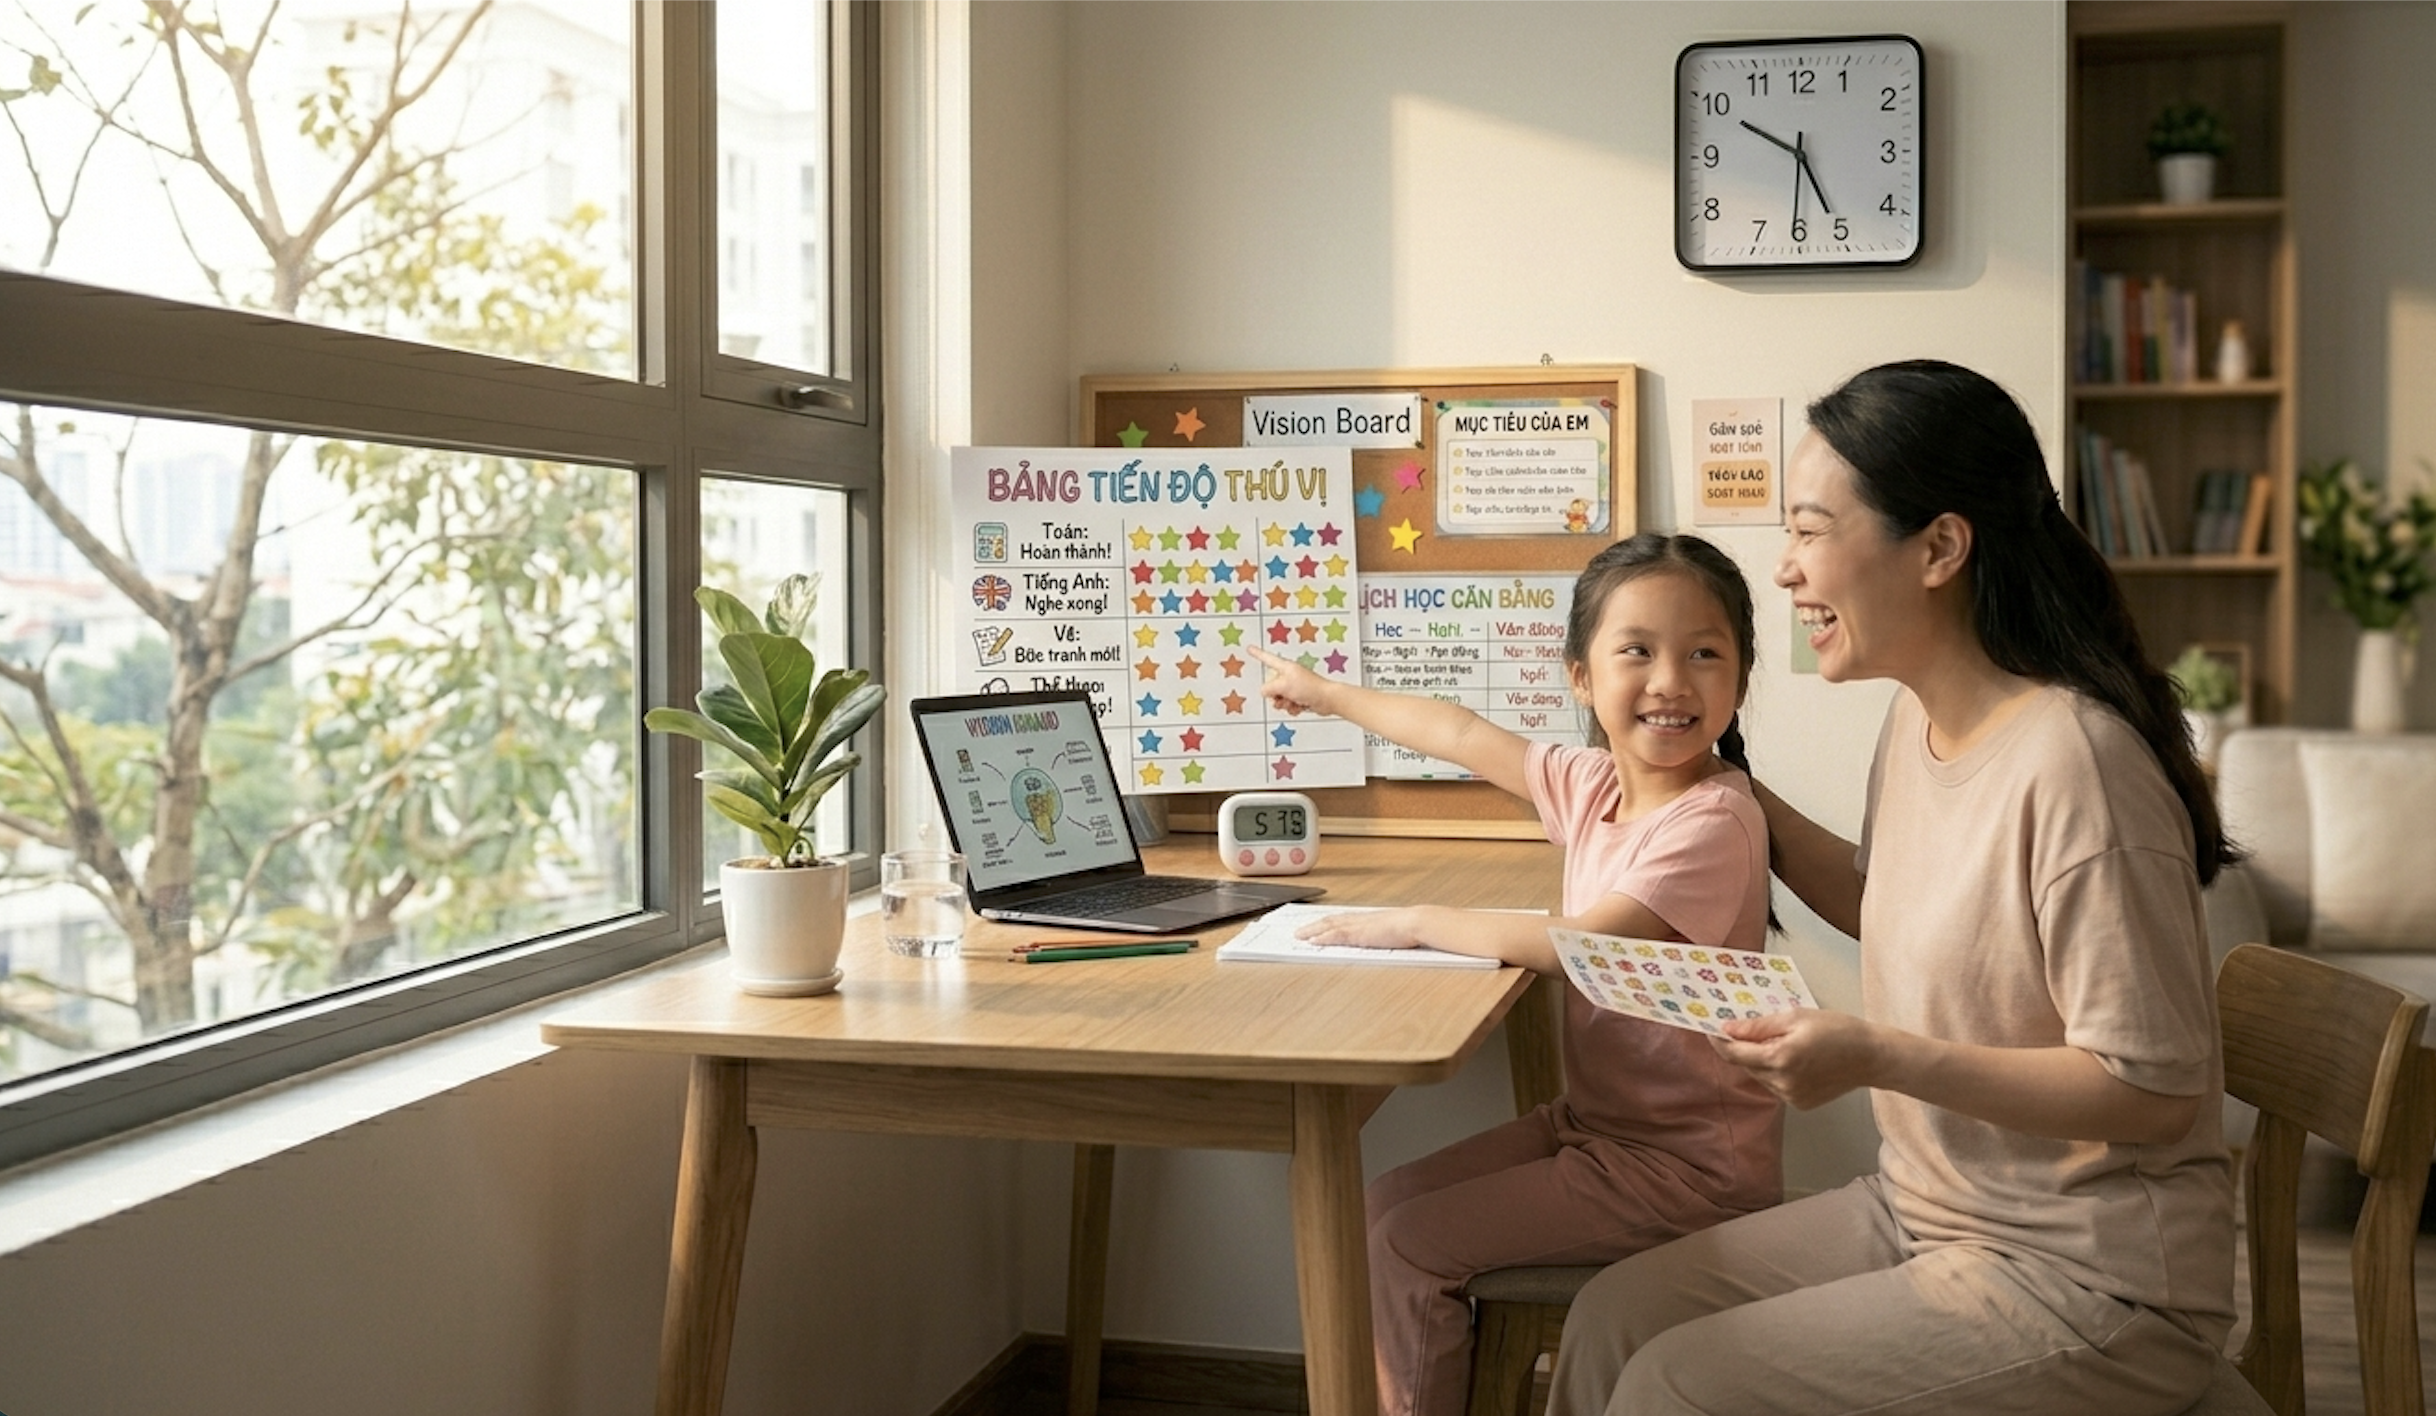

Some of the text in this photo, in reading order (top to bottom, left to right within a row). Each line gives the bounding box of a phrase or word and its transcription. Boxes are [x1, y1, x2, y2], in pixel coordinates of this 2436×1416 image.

[1746, 70, 1847, 96] 11 12 1
[1702, 87, 1896, 116] 10 2
[1703, 140, 1896, 169] 9 3
[1703, 194, 1897, 221] 8 4
[1752, 218, 1849, 242] 7 6 5
[1252, 407, 1410, 435] Vision Board
[1566, 415, 1589, 430] EM
[988, 459, 1327, 509] BẢNG TIẾN ĐỘ THÚ VỊ
[1042, 522, 1088, 540] Toán:
[1072, 572, 1110, 590] Anh:
[1404, 588, 1446, 613] HỌC
[1049, 646, 1086, 662] tranh
